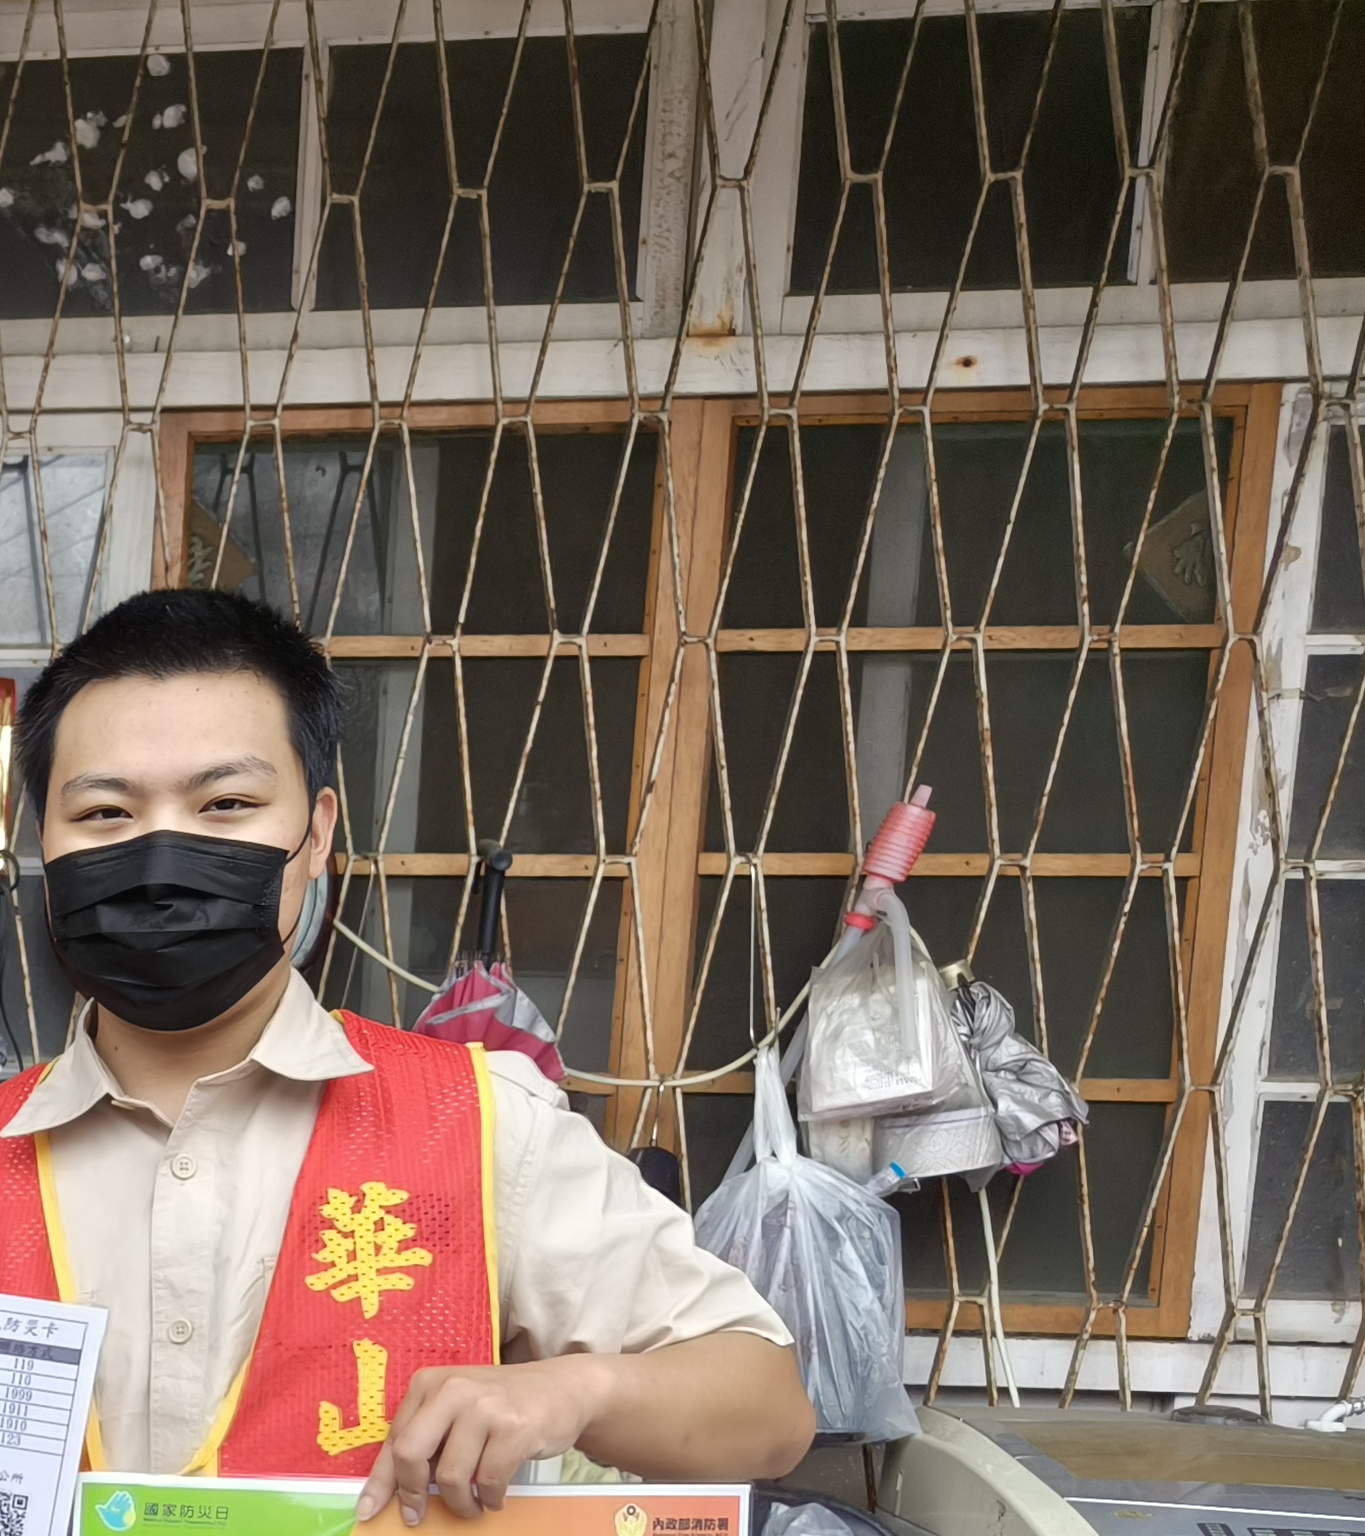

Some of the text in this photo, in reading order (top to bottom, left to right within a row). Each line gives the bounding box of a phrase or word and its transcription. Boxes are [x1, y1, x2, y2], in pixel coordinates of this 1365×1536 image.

[305, 1181, 433, 1456] 華山
[13, 1357, 35, 1372] 119
[11, 1372, 32, 1387] 110
[4, 1386, 34, 1402] 1999
[2, 1401, 29, 1417] 1911
[0, 1416, 28, 1433] 1910
[0, 1431, 21, 1447] 123
[144, 1502, 229, 1520] 國家防災日
[652, 1517, 729, 1531] 內政部消防署
